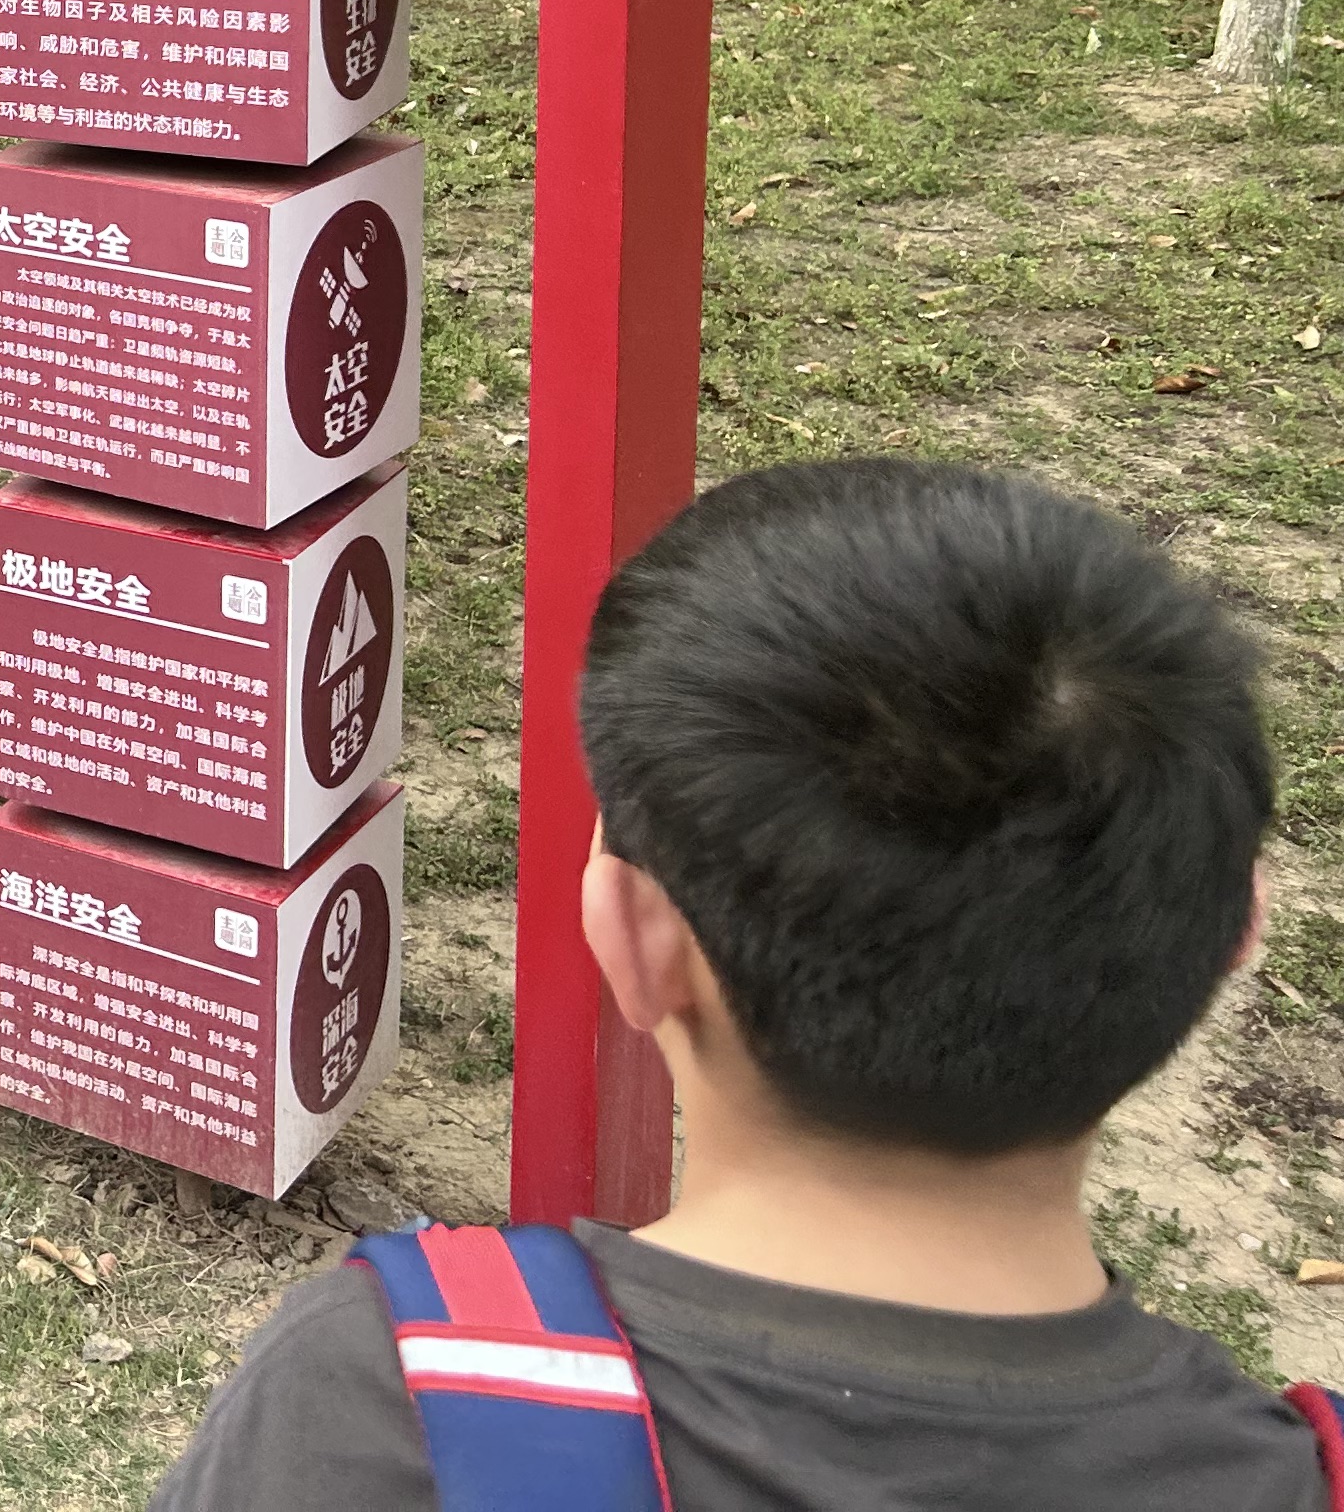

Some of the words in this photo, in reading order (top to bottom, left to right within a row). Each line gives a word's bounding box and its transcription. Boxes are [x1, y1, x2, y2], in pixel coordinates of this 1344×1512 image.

[346, 33, 376, 86] 安全
[325, 342, 369, 400] 太空
[324, 391, 368, 450] 安全
[2, 550, 151, 613] 极地安全
[331, 665, 364, 731] 极地
[330, 715, 363, 777] 安全
[0, 768, 53, 796] 的安全。
[0, 869, 141, 943] 海洋安全
[323, 992, 359, 1054] 深海
[0, 1074, 52, 1104] 的安全。
[321, 1038, 357, 1102] 安全
